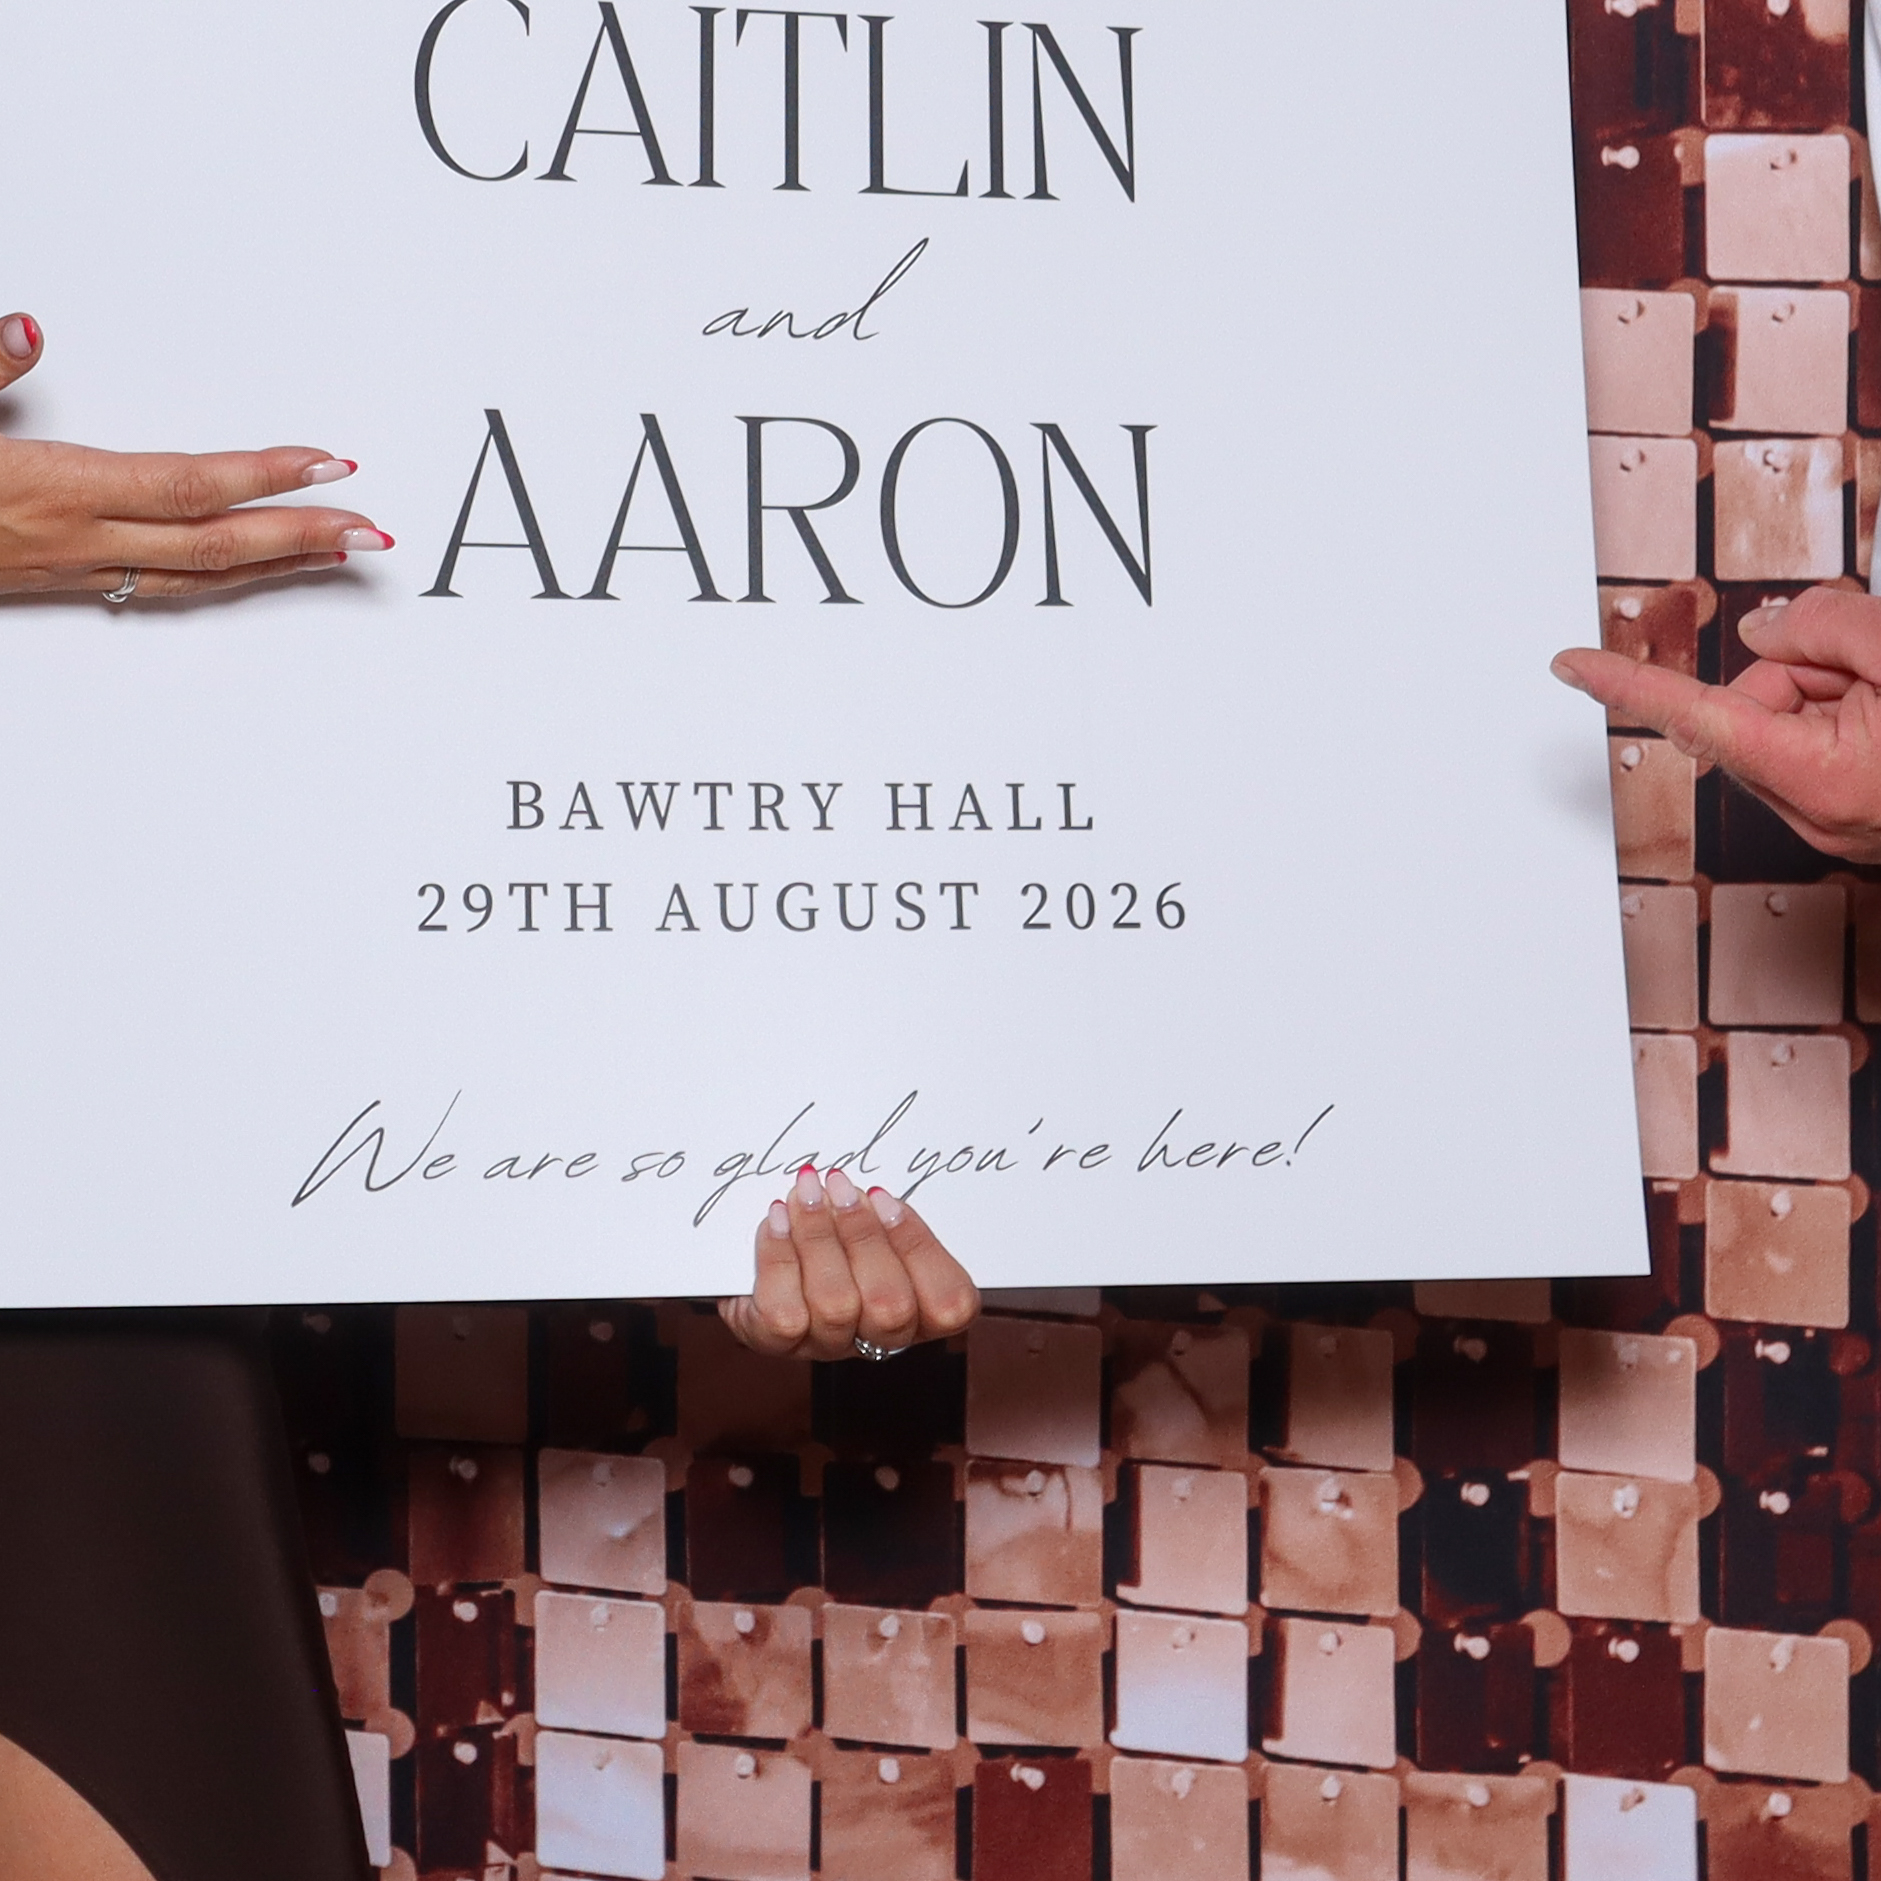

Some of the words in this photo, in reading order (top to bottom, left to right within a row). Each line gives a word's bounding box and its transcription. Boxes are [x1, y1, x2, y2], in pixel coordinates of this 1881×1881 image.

[702, 237, 929, 341] and
[418, 408, 1158, 609] AARON
[506, 781, 843, 831] BAWTRY
[884, 783, 1093, 831] HALL
[418, 883, 613, 933] 29TH
[655, 882, 979, 932] AUGUST
[1021, 882, 1185, 930] 2026
[291, 1090, 461, 1208] We
[483, 1153, 598, 1180] are
[621, 1151, 685, 1182] so
[692, 1089, 918, 1227] glad
[898, 1117, 1112, 1202] you're
[1137, 1104, 1335, 1172] here!
